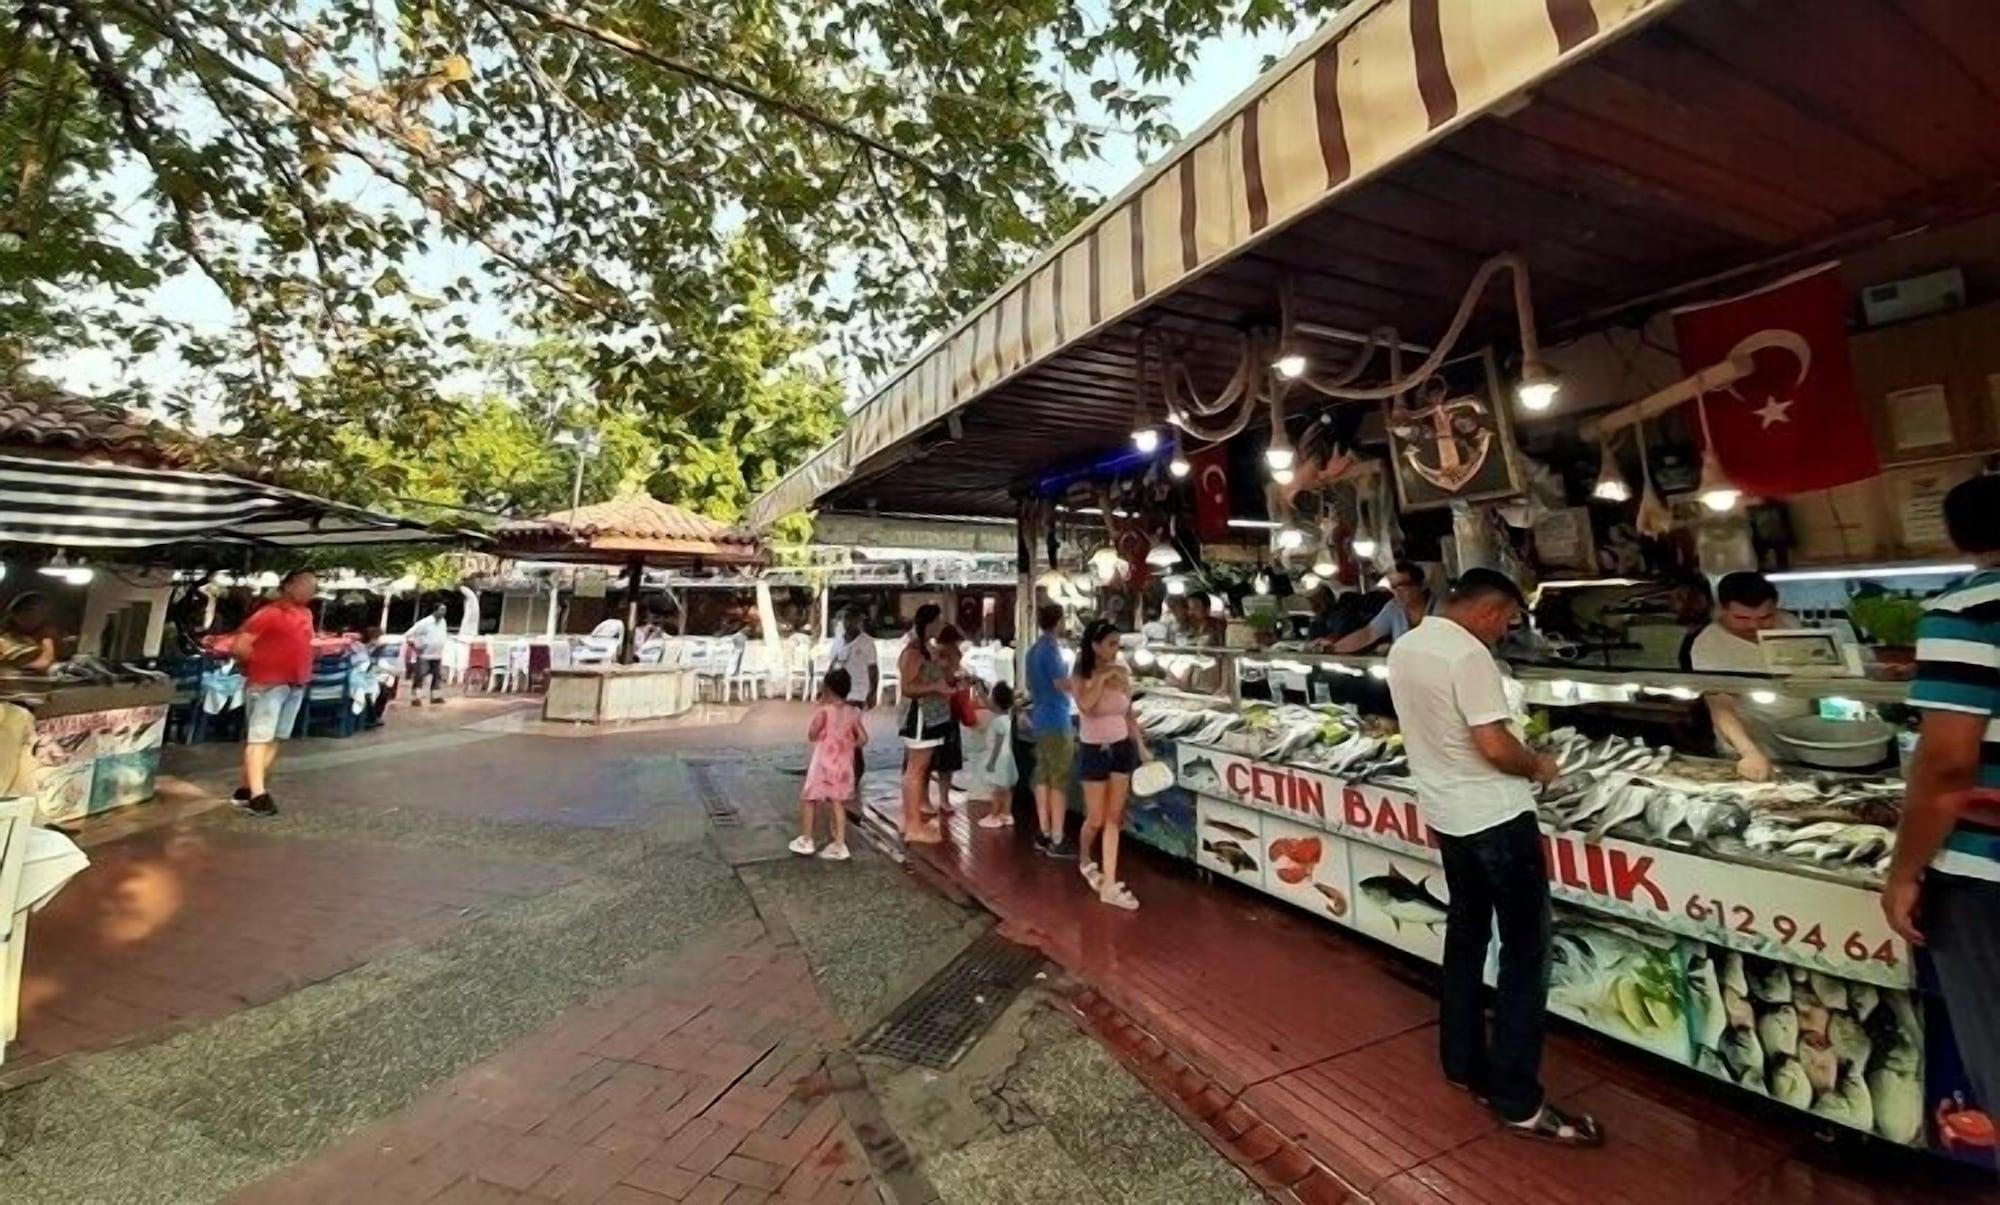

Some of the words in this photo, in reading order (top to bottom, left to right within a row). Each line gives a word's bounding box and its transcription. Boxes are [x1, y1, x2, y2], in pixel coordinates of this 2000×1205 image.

[1227, 762, 1326, 818] ÇETİN
[1773, 914, 1827, 951] 94
[1844, 931, 1899, 967] 64
